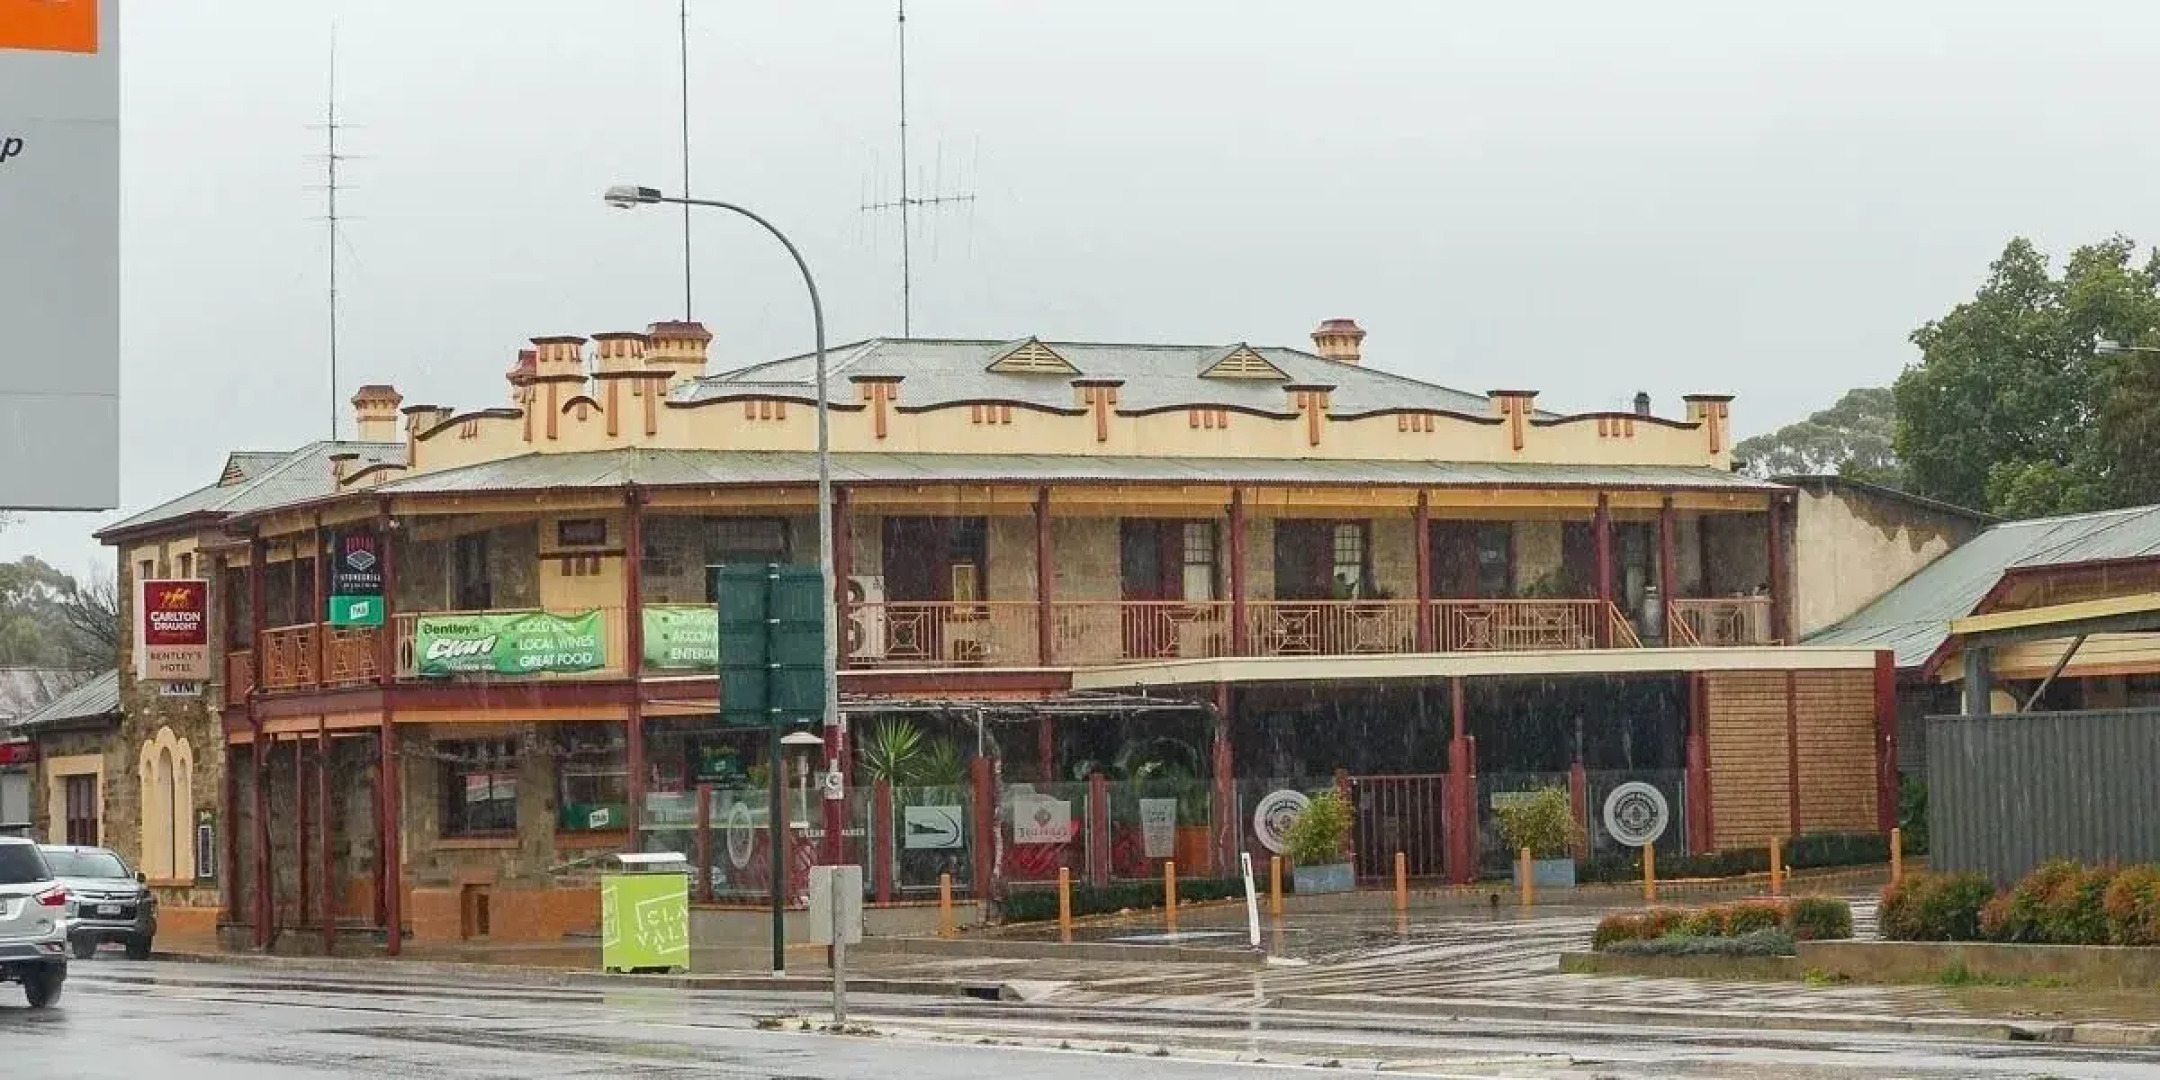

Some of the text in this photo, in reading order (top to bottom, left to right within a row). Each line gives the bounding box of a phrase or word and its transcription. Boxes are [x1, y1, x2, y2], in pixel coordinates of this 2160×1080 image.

[150, 611, 200, 622] CARLTON
[154, 622, 199, 631] DRAUGHT
[519, 635, 595, 651] LOCAL WINES
[151, 651, 202, 660] BENTLEY'S
[519, 653, 593, 667] GREAT FOOD
[160, 664, 192, 672] HOTEL
[169, 683, 196, 693] ATM
